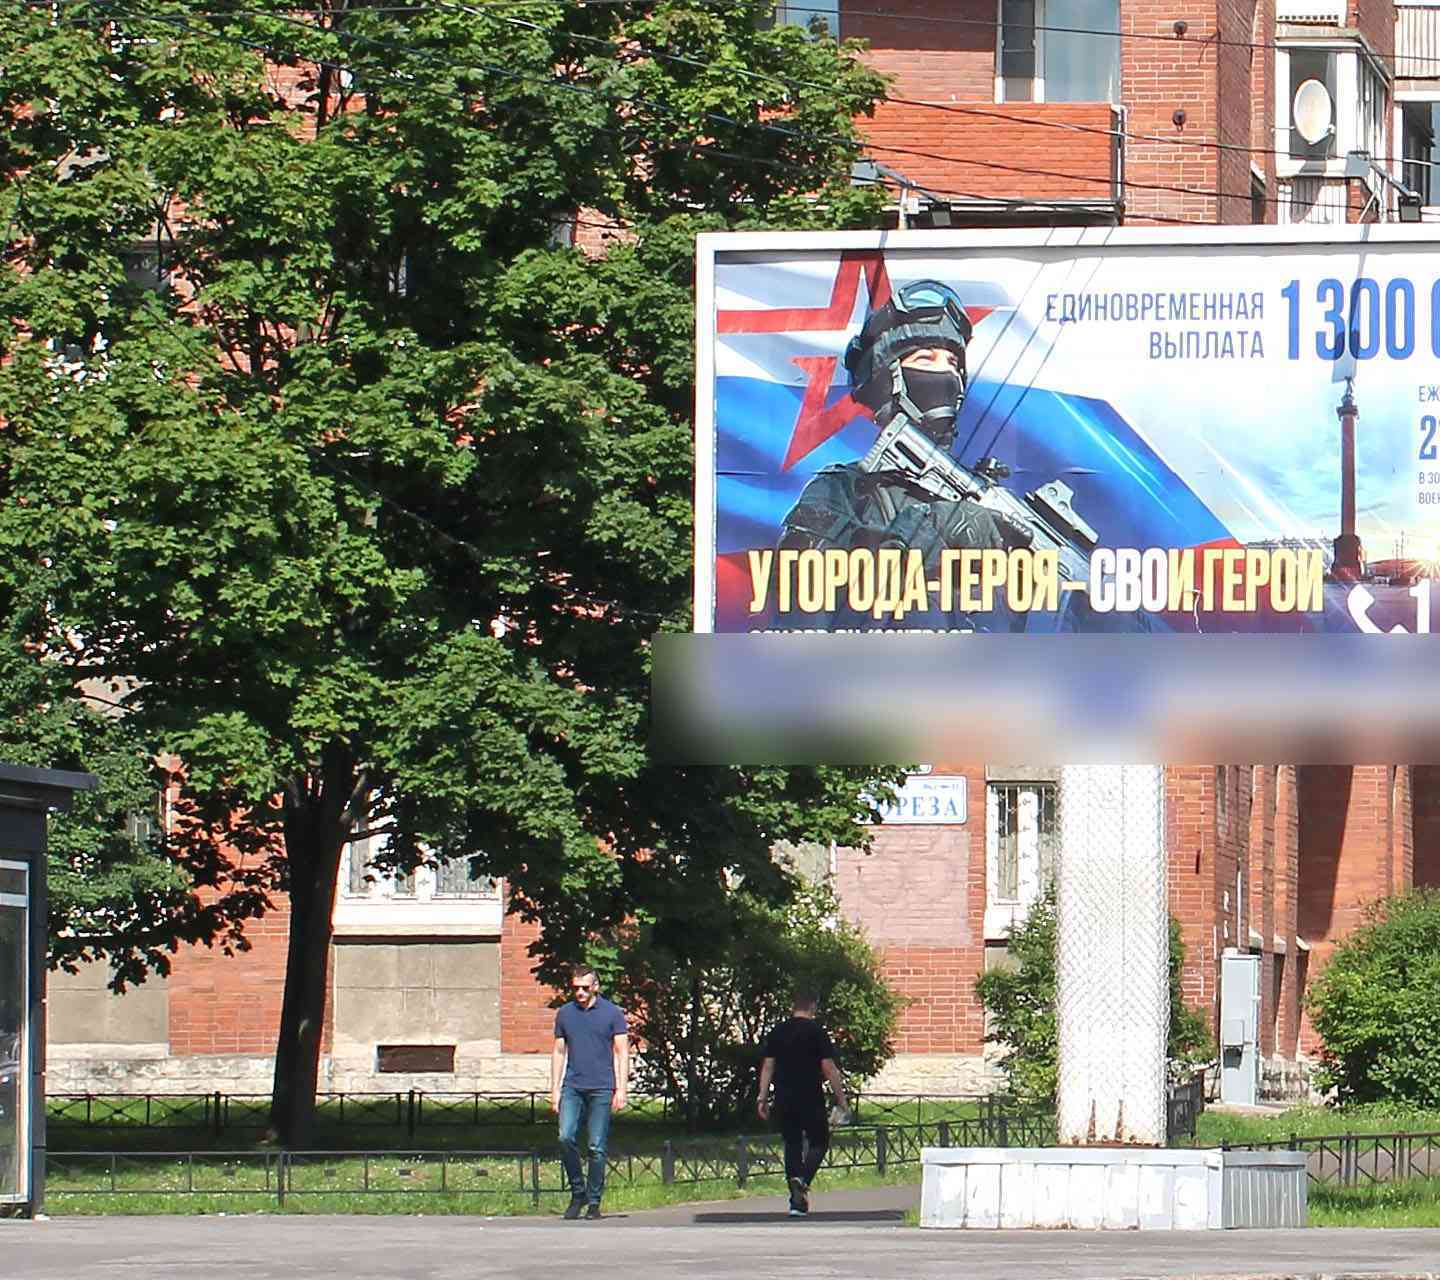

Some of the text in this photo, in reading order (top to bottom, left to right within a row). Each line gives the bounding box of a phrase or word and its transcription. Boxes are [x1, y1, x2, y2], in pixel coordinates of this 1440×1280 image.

[1045, 292, 1264, 325] ЕДИНОВРЕМЕННАЯ
[1280, 279, 1300, 360] 1
[1315, 278, 1415, 360] 300
[1149, 330, 1264, 359] ВЫПЛАТА
[748, 549, 773, 613] У
[779, 548, 1058, 620] ГОРОДА-ГЕРОЯ
[1089, 548, 1195, 613] СВОИ
[1202, 548, 1324, 613] ГЕРОИ
